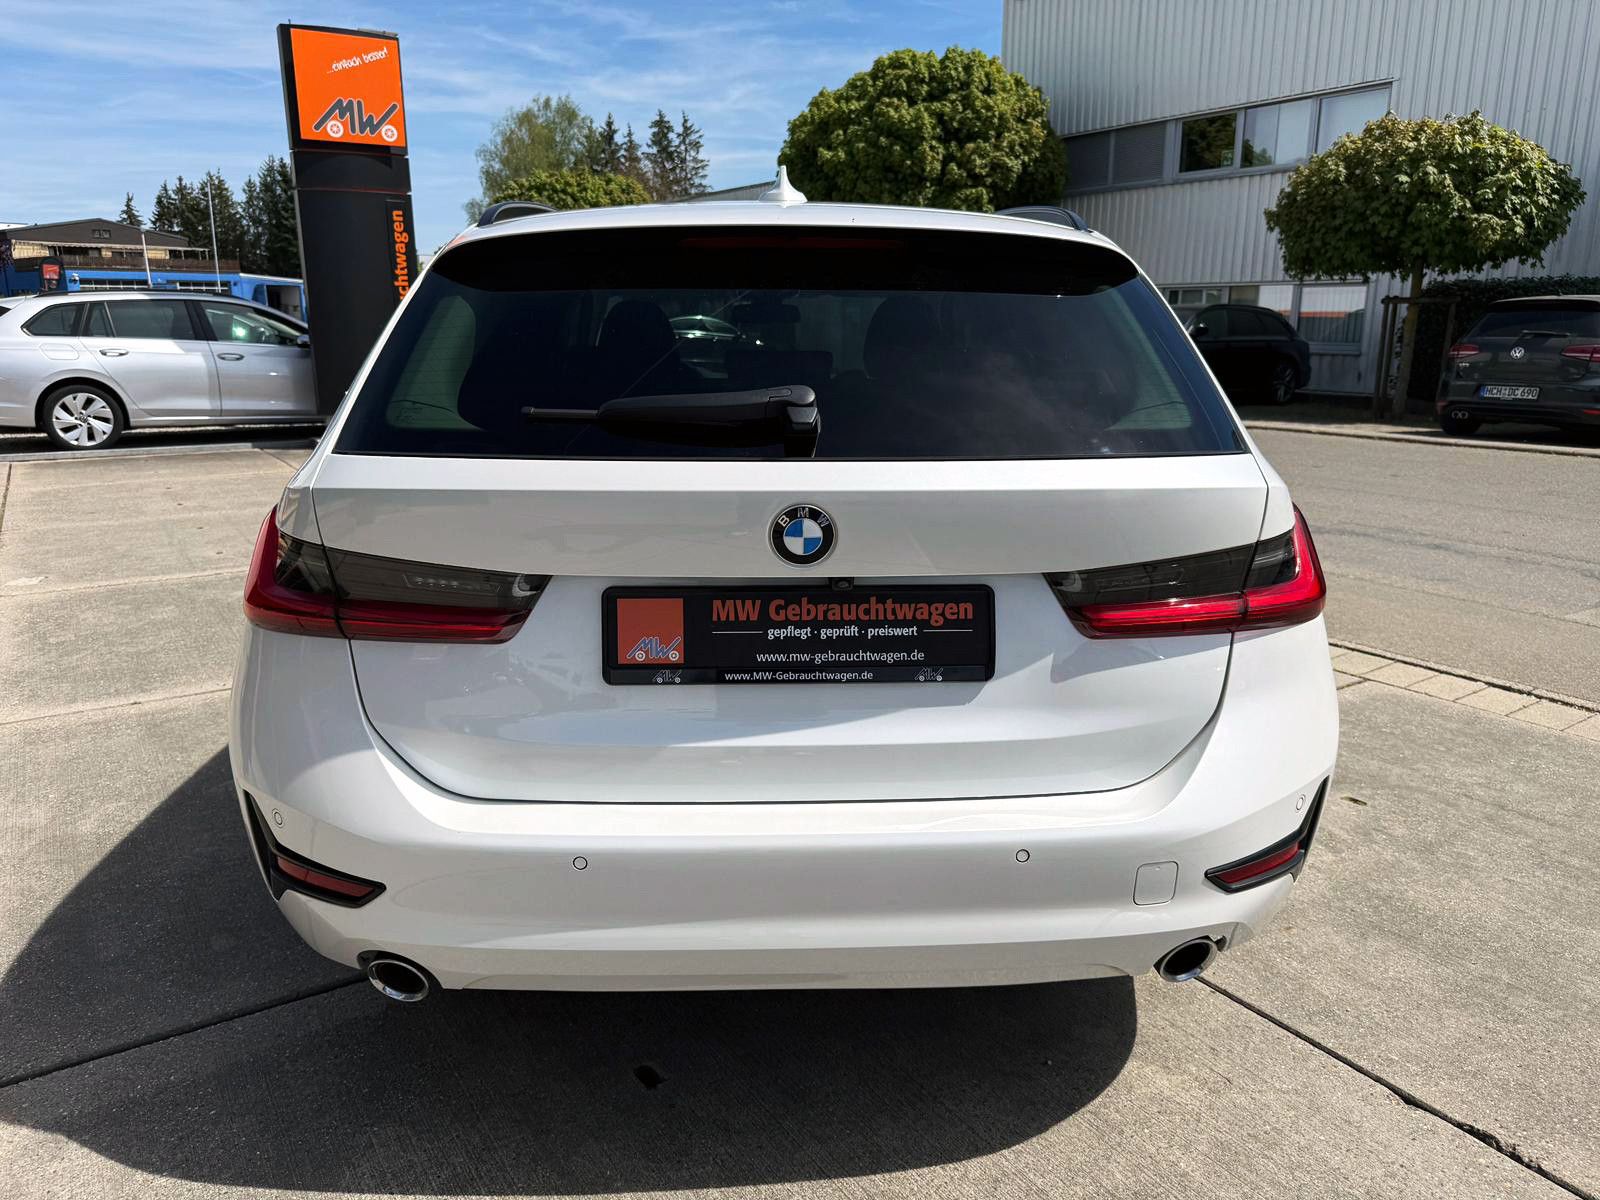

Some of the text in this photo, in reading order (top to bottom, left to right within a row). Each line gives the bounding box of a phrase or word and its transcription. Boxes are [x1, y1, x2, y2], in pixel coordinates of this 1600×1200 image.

[313, 97, 398, 137] MW
[392, 210, 410, 300] chtwagen
[1520, 387, 1538, 398] 690
[778, 507, 829, 527] BMW
[712, 596, 974, 627] MW Gebrauchtwagen
[767, 625, 918, 640] gepflegt geprüft preiswert
[626, 636, 682, 662] MW
[756, 650, 925, 664] www.mw-gebrauchtwagen.de
[725, 671, 874, 682] www.MW-Gebrauchtwagen.de
